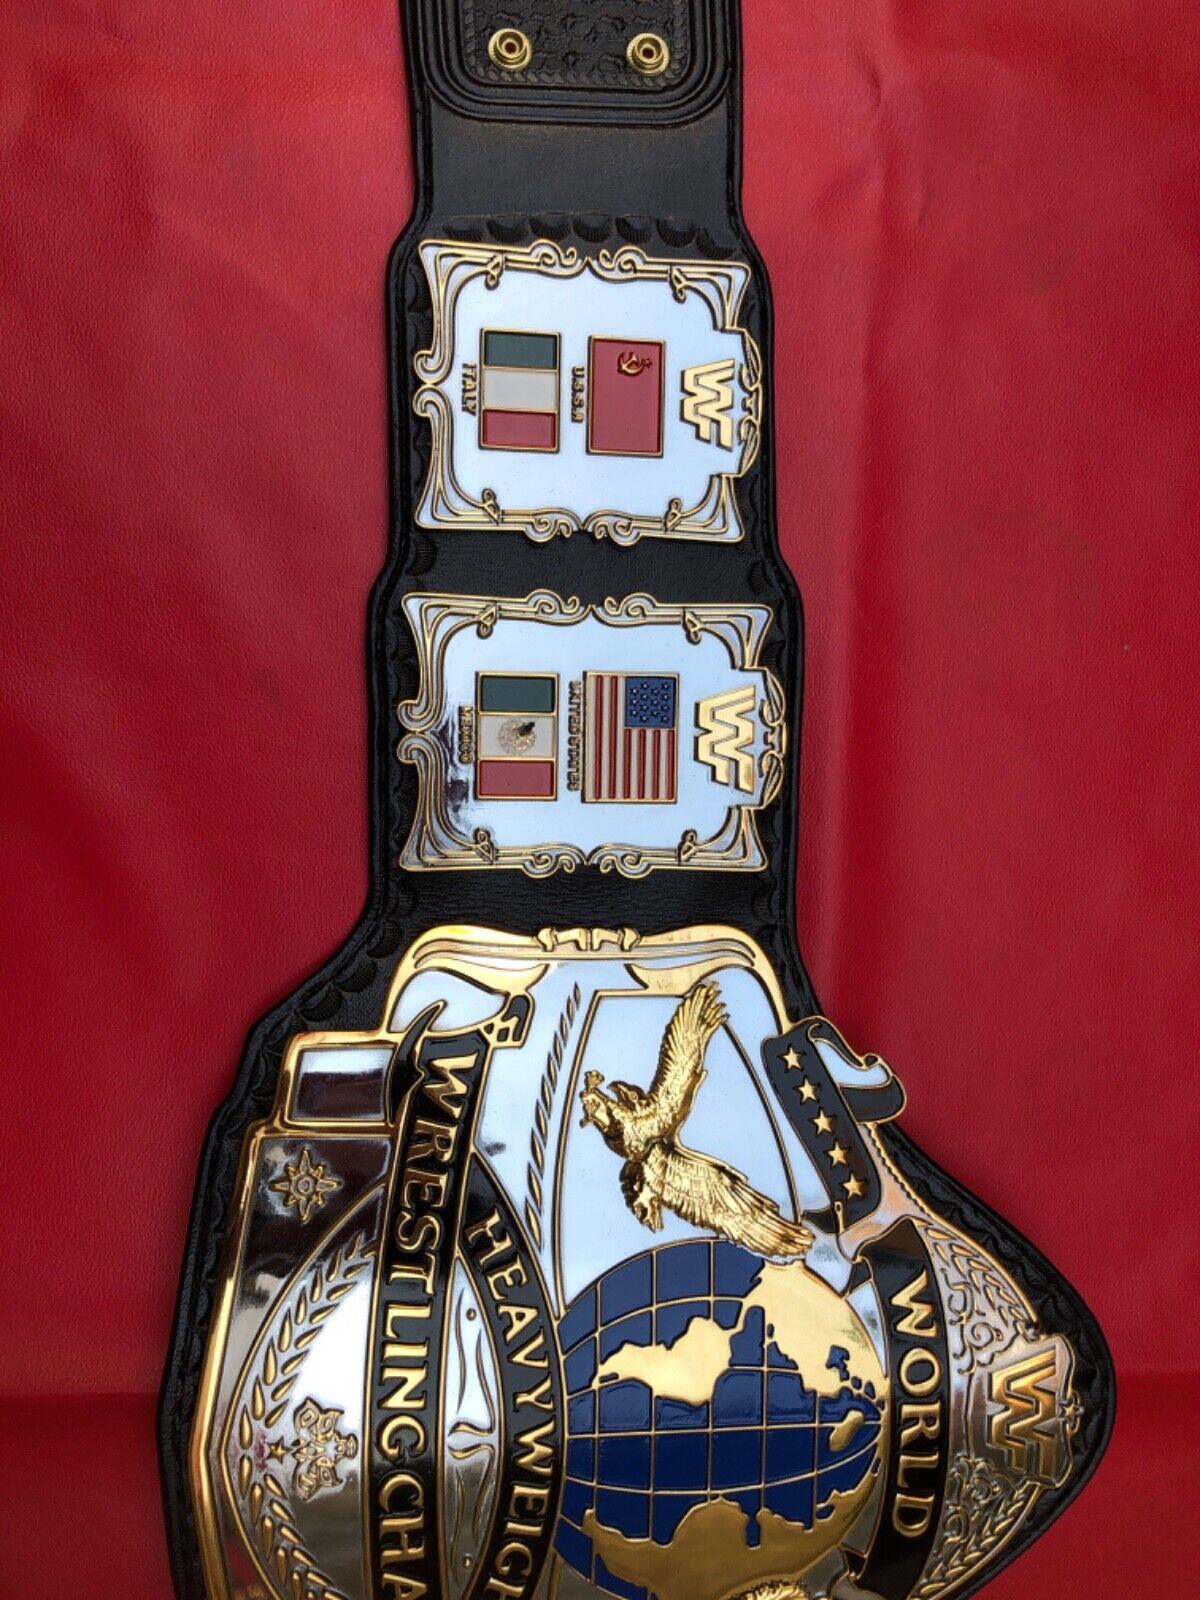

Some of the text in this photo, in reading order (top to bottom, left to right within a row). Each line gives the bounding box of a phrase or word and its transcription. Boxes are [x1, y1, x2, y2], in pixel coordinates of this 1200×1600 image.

[462, 362, 479, 417] ITALY
[458, 704, 474, 765] MEXICO
[567, 679, 583, 792] UNITED STATES
[379, 1049, 479, 1459] WRESTLING
[890, 1268, 942, 1539] WORLD
